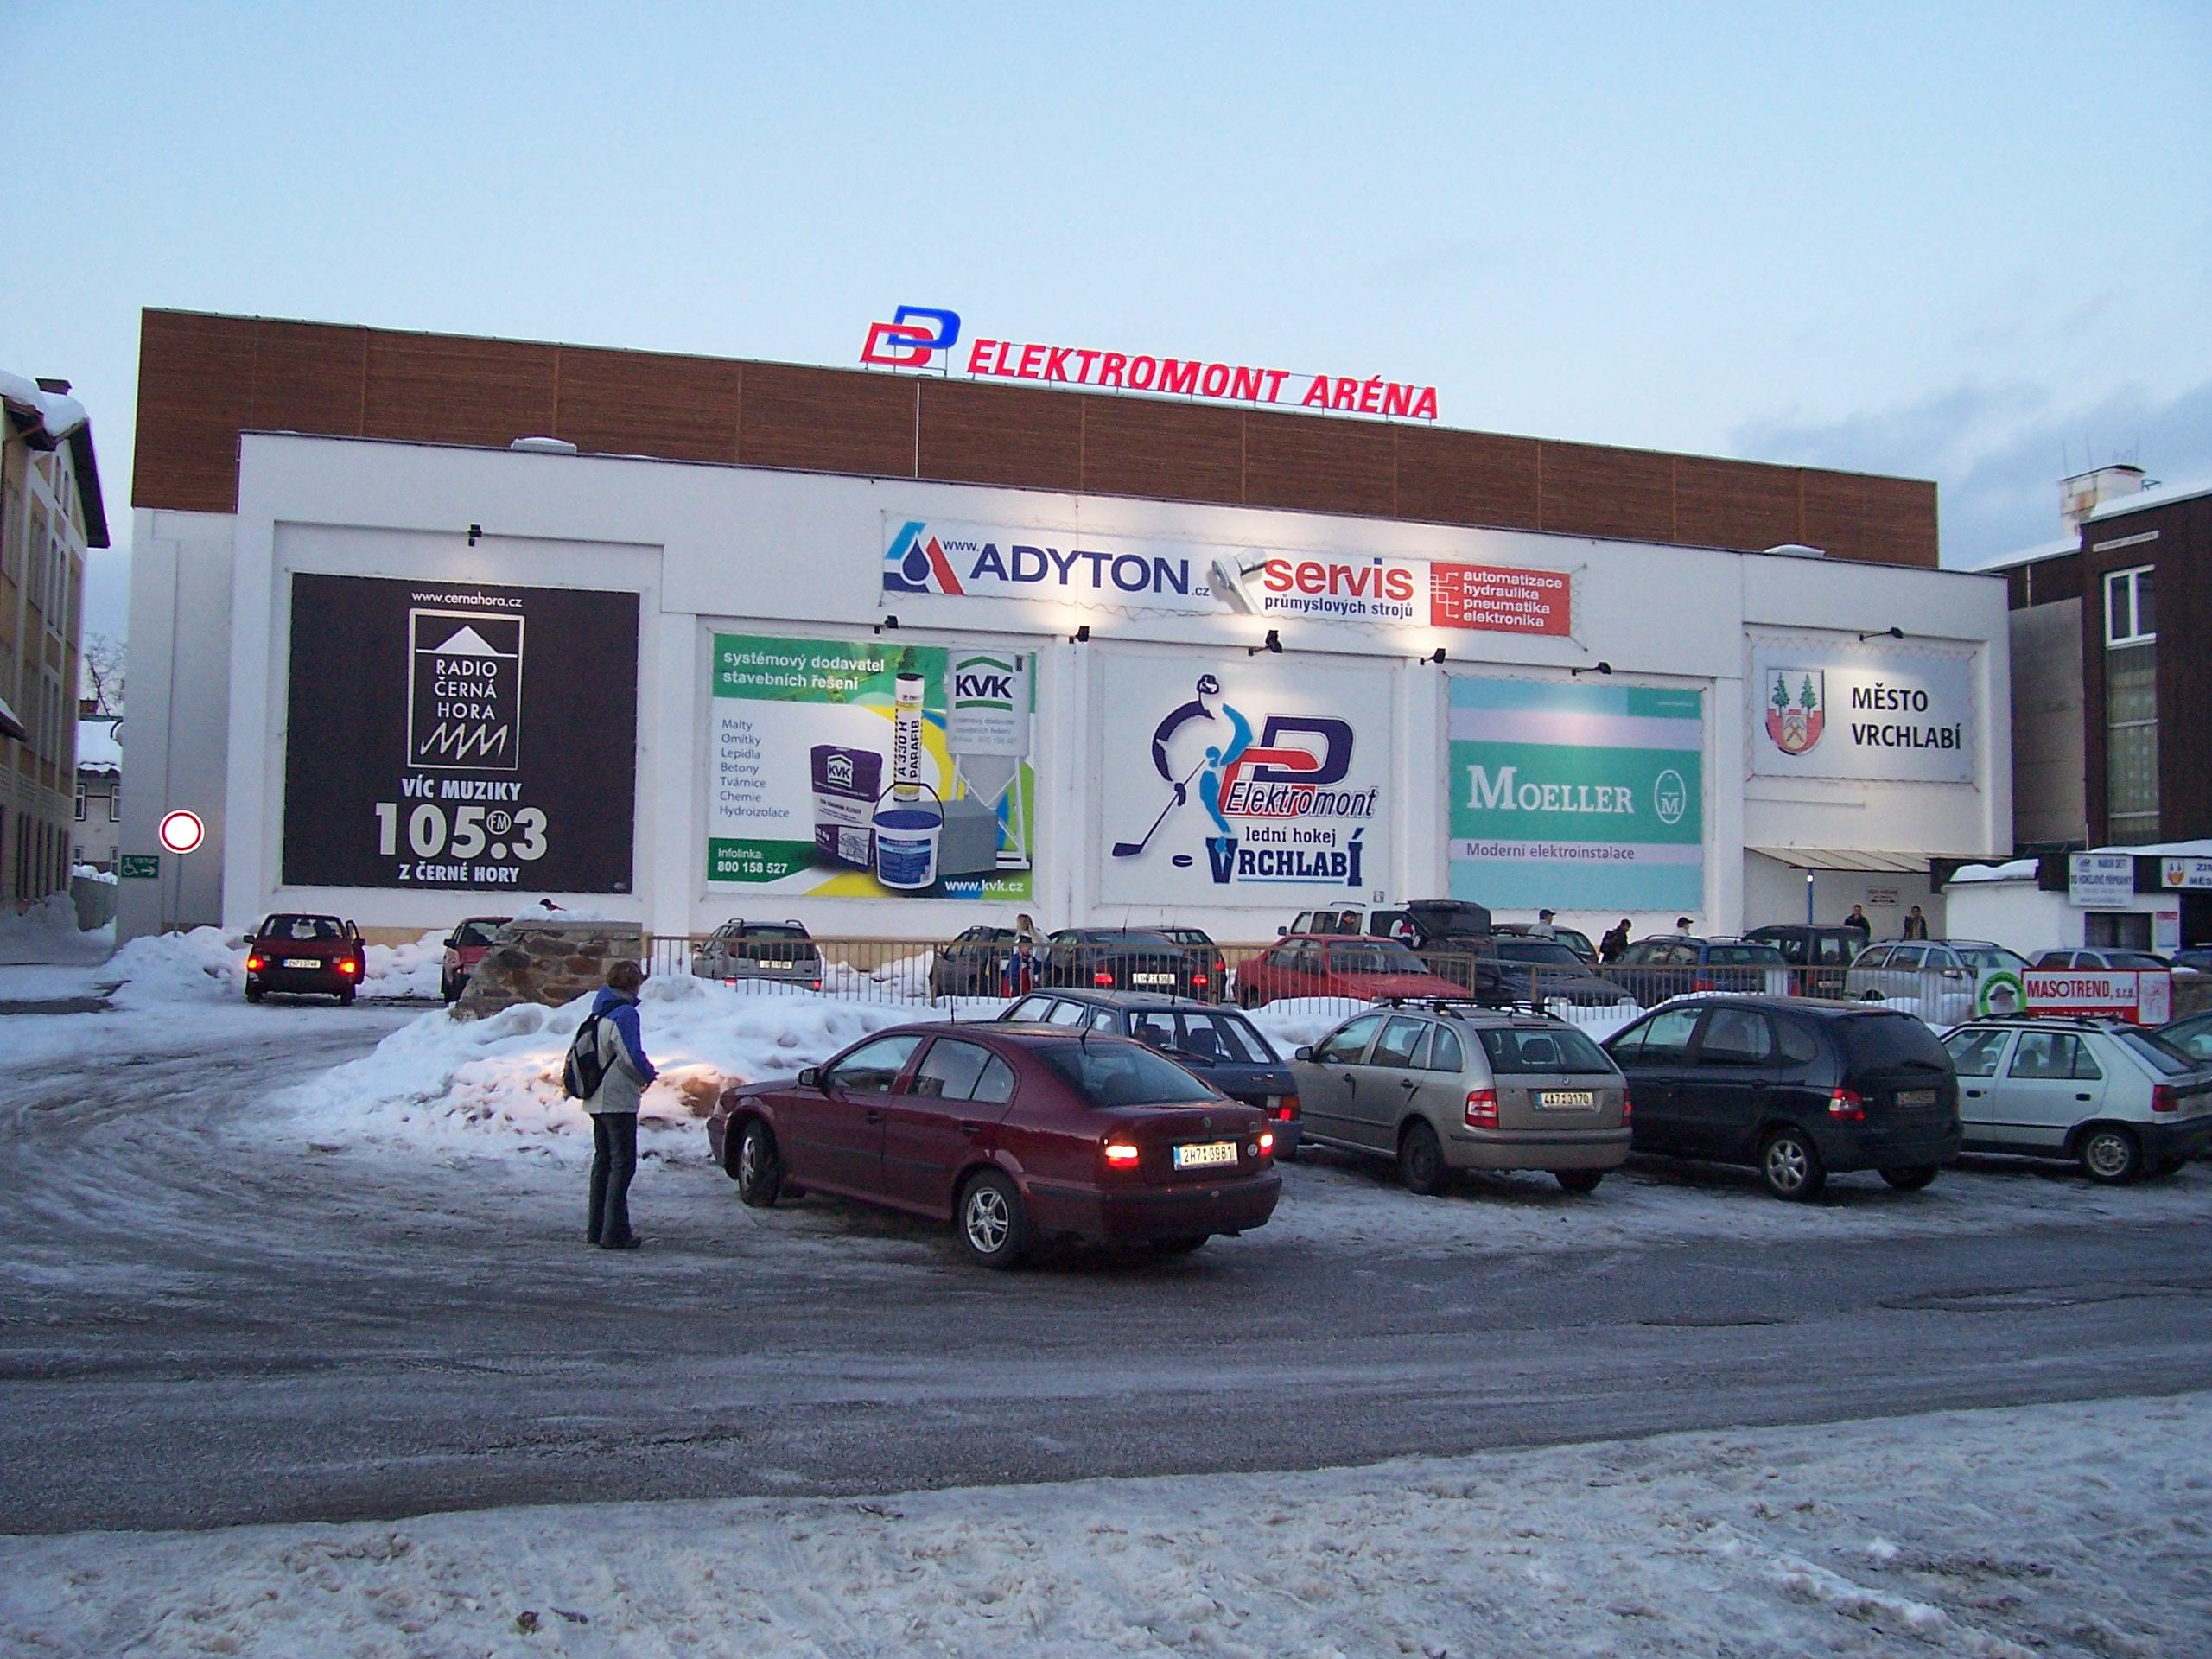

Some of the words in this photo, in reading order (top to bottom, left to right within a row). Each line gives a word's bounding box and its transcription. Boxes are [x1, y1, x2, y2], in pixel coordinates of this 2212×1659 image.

[966, 338, 1291, 404] ELEKTROMONT
[1301, 374, 1438, 420] ARÉNA
[1263, 557, 1414, 601] servis
[1463, 570, 1563, 589] automatizace
[410, 590, 524, 608] www.cernahora.cz
[1463, 582, 1540, 601] hydraulika
[1264, 594, 1366, 616] průmyslových
[1371, 601, 1414, 620] strojů
[1463, 597, 1551, 615] pneumatika
[1463, 610, 1545, 628] elektronika
[435, 658, 498, 677] RADIO
[723, 651, 807, 671] systémový
[811, 655, 886, 673] dodavatel
[434, 676, 498, 699] ČERNÁ
[722, 671, 807, 688] stavebních
[955, 674, 1013, 700] KVK
[1852, 682, 1929, 713] MĚSTO
[436, 702, 496, 721] HORA
[721, 718, 753, 733] Malty
[898, 721, 908, 733] H
[721, 733, 762, 748] Omítky
[1851, 722, 1962, 750] VRCHLABÍ
[721, 747, 761, 760] Lepidla
[898, 735, 908, 764] 330
[909, 719, 920, 779] PARAFIB
[721, 761, 760, 776] Betony
[829, 765, 850, 780] KVK
[898, 766, 907, 778] A
[401, 773, 435, 798] VÍC
[440, 779, 523, 802] MUZIKY
[720, 776, 767, 788] Tvárnice
[719, 790, 762, 803] Chemie
[1224, 780, 1378, 817] Elektromont
[719, 805, 791, 819] Hydroizolace
[1245, 826, 1288, 843] lední
[1293, 827, 1337, 848] hokej
[1205, 827, 1366, 887] VRCHLABÍ
[1530, 843, 1636, 860] elektroinstalace
[398, 863, 410, 880] Z
[416, 861, 468, 882] ČERNÉ
[474, 866, 520, 884] HORY
[717, 861, 740, 873] 800
[742, 861, 764, 874] 158
[766, 861, 789, 874] 527
[944, 879, 1024, 893] www.kvk.cz
